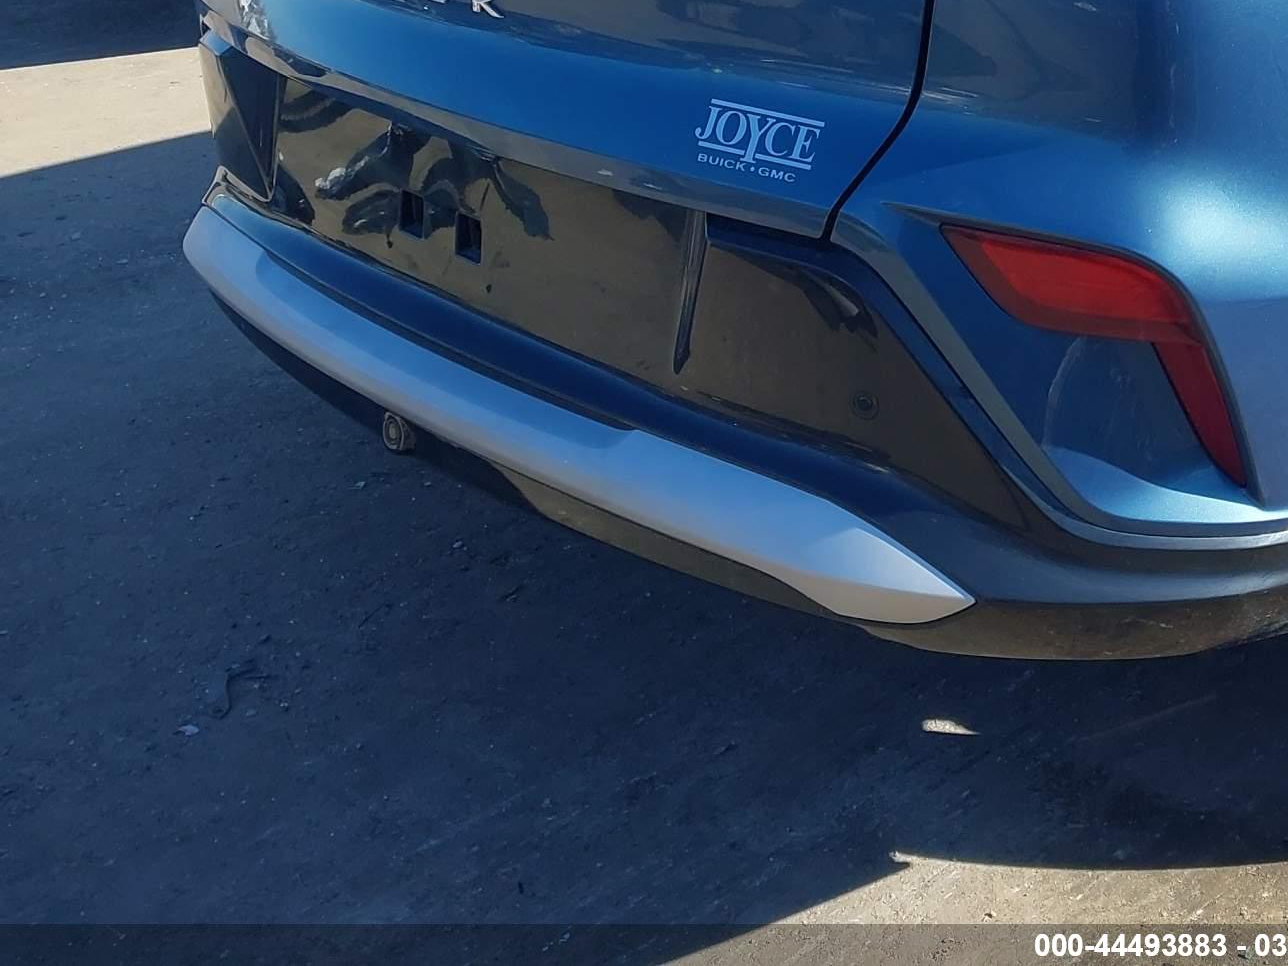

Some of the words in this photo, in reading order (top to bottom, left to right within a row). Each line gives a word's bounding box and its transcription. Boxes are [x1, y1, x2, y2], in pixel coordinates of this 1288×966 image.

[694, 105, 821, 164] JOYCE
[697, 153, 748, 172] BUICK
[757, 166, 797, 183] GMC
